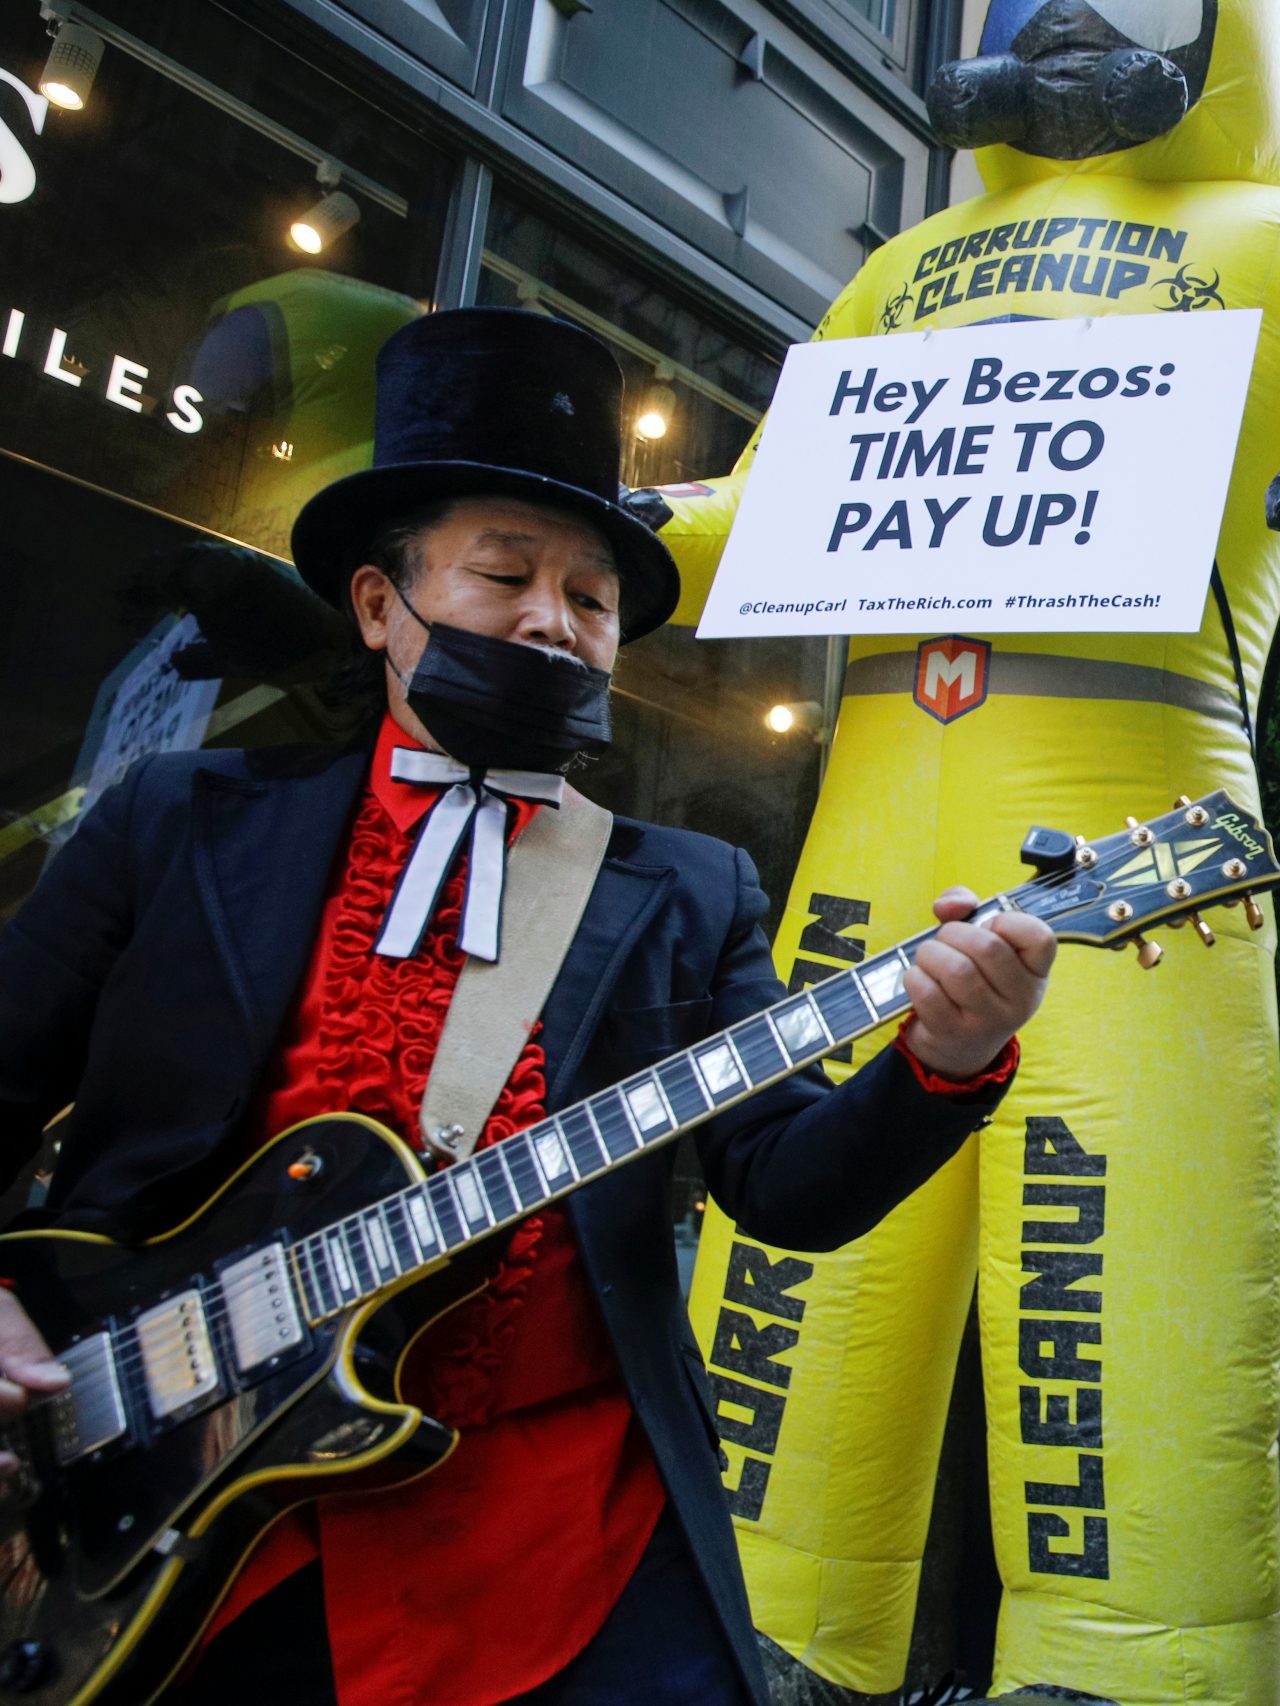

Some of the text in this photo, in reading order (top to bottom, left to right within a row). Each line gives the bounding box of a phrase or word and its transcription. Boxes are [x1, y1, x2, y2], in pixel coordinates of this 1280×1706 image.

[913, 218, 1187, 284] CORRUPTION
[914, 253, 1150, 321] CLEANUP
[1, 306, 205, 434] ILES
[828, 356, 1176, 425] Hey Bezos:
[847, 419, 1105, 482] TIME TO
[826, 489, 1100, 553] PAY UP!
[738, 593, 1162, 617] @CleanupCarl TaxTheRich.com #ThrashTheCash!
[924, 653, 978, 702] M
[1211, 813, 1265, 860] Gibson
[1019, 1115, 1106, 1579] CLEANUP
